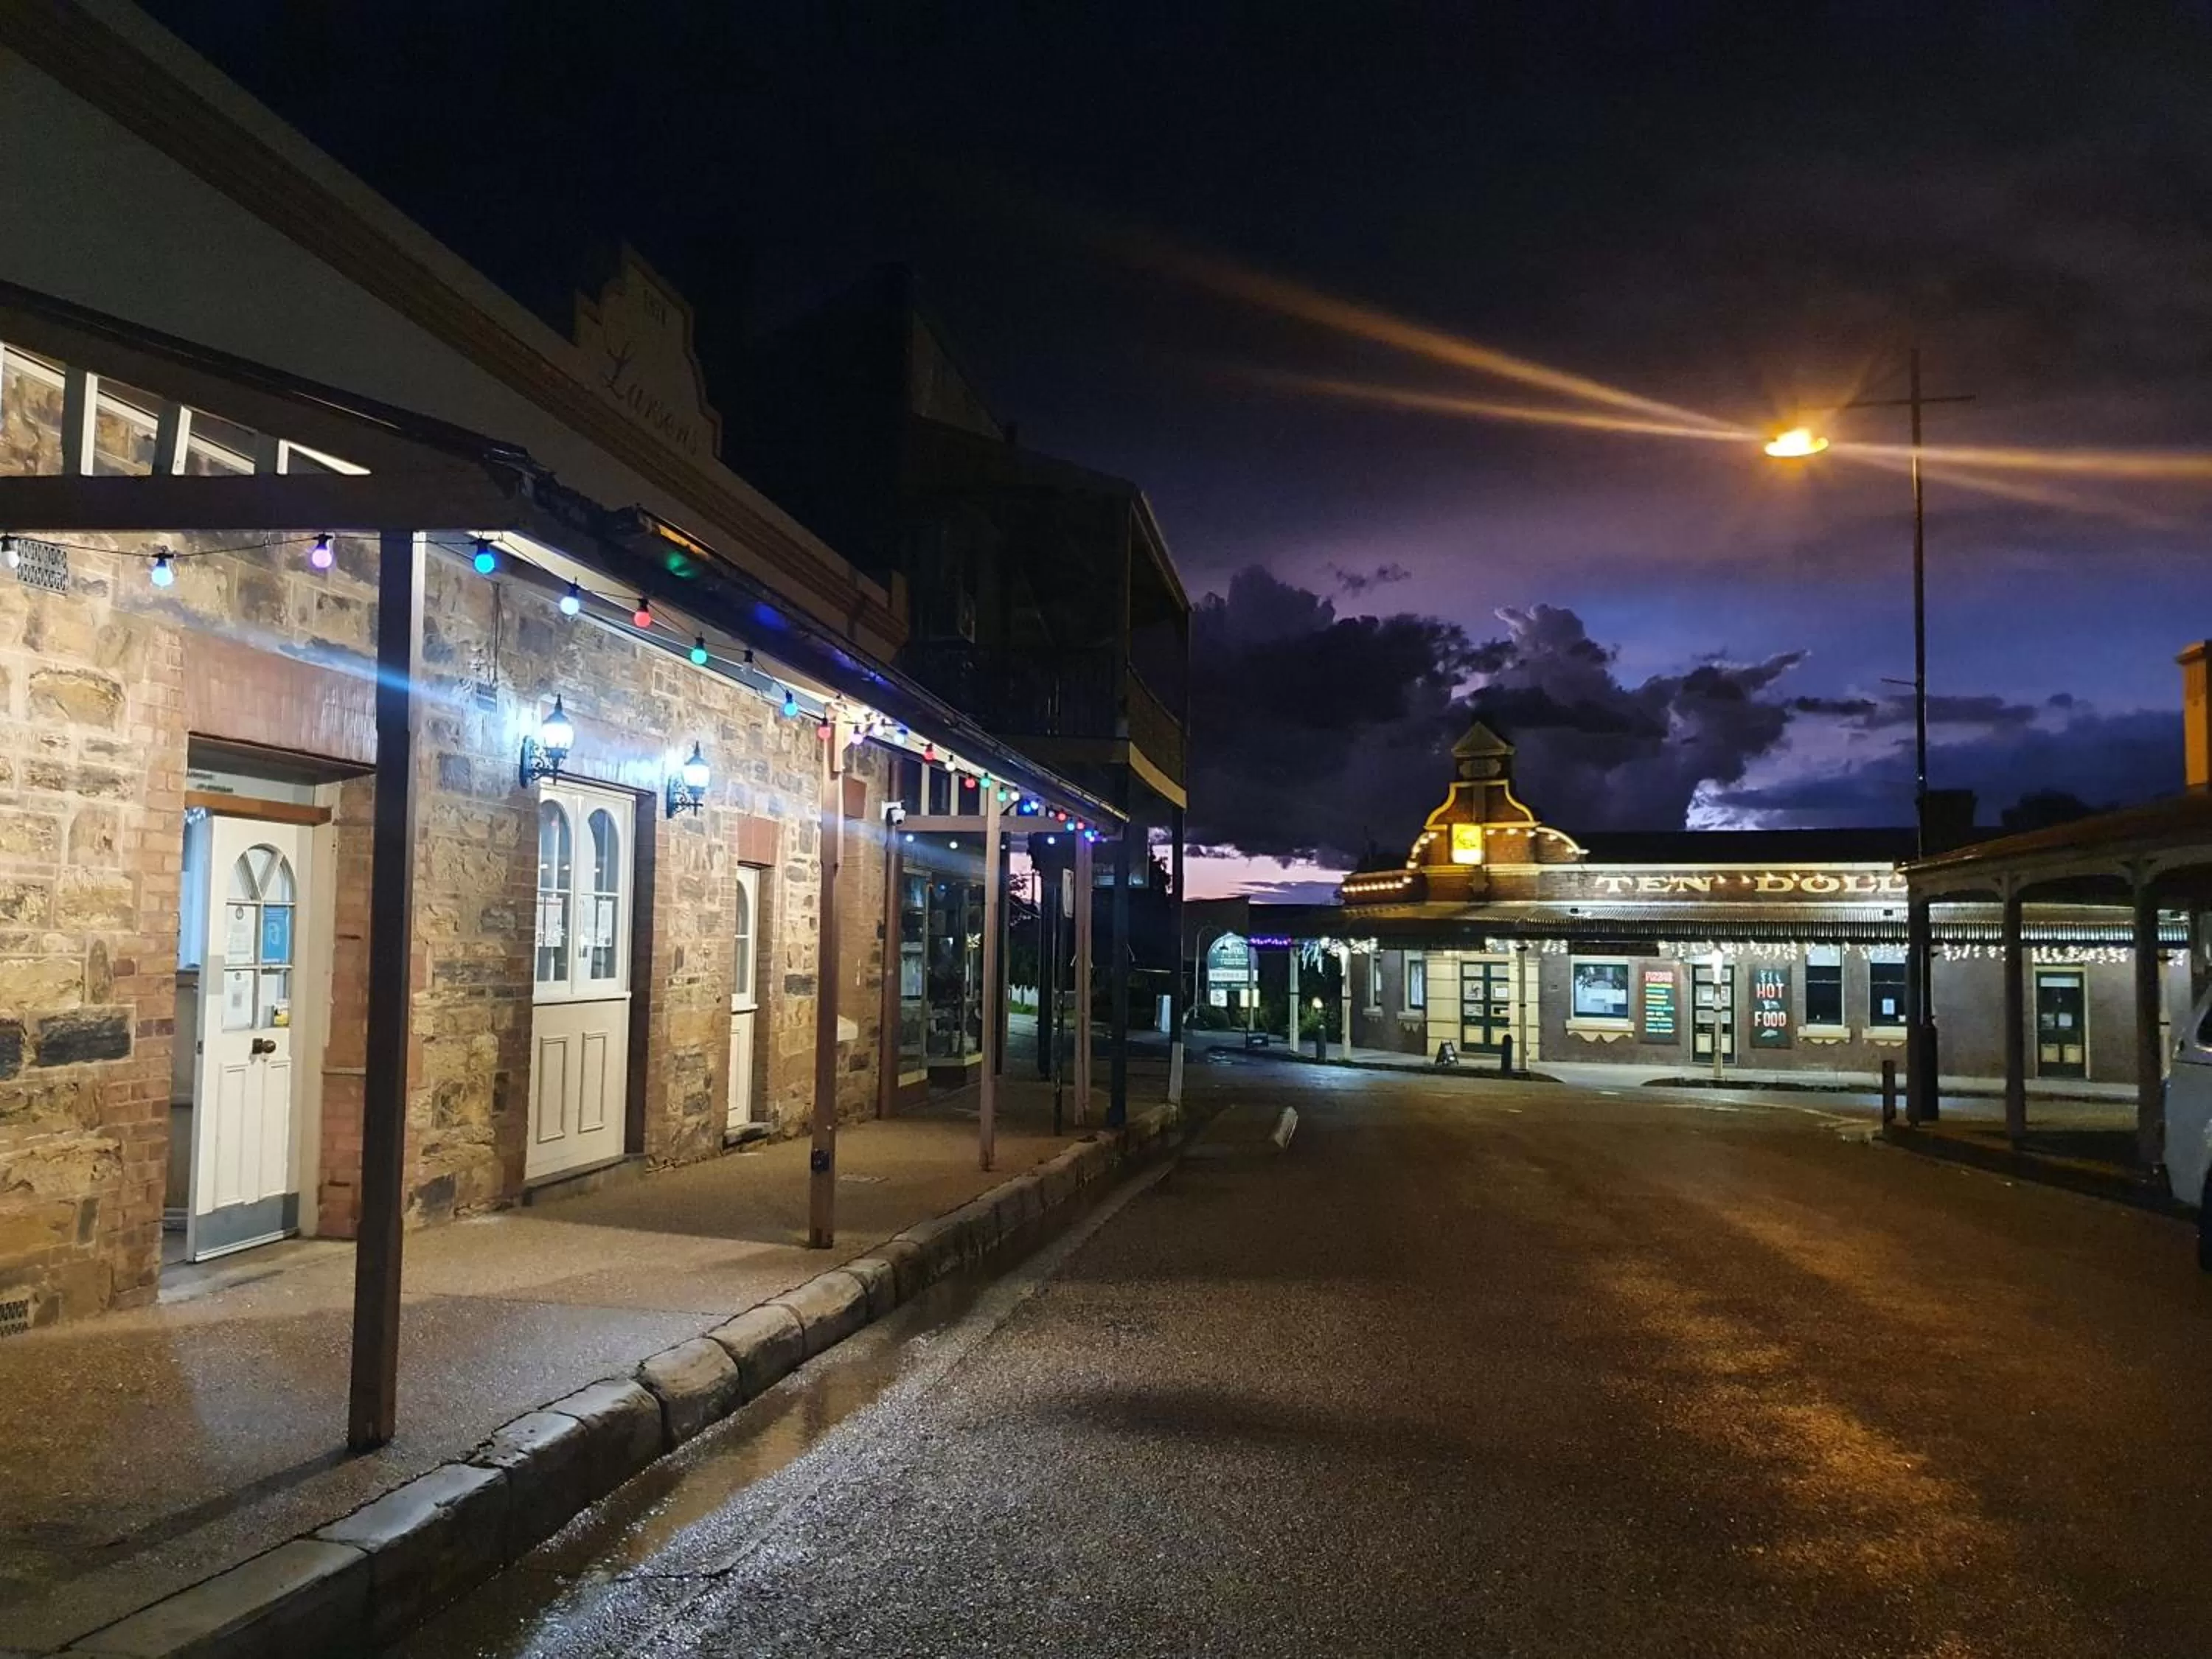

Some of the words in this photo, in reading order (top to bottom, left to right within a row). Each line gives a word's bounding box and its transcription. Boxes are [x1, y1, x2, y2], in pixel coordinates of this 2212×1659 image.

[1595, 874, 1714, 893] TEN
[1756, 982, 1784, 998] HOT
[1753, 1011, 1787, 1027] FOOD
